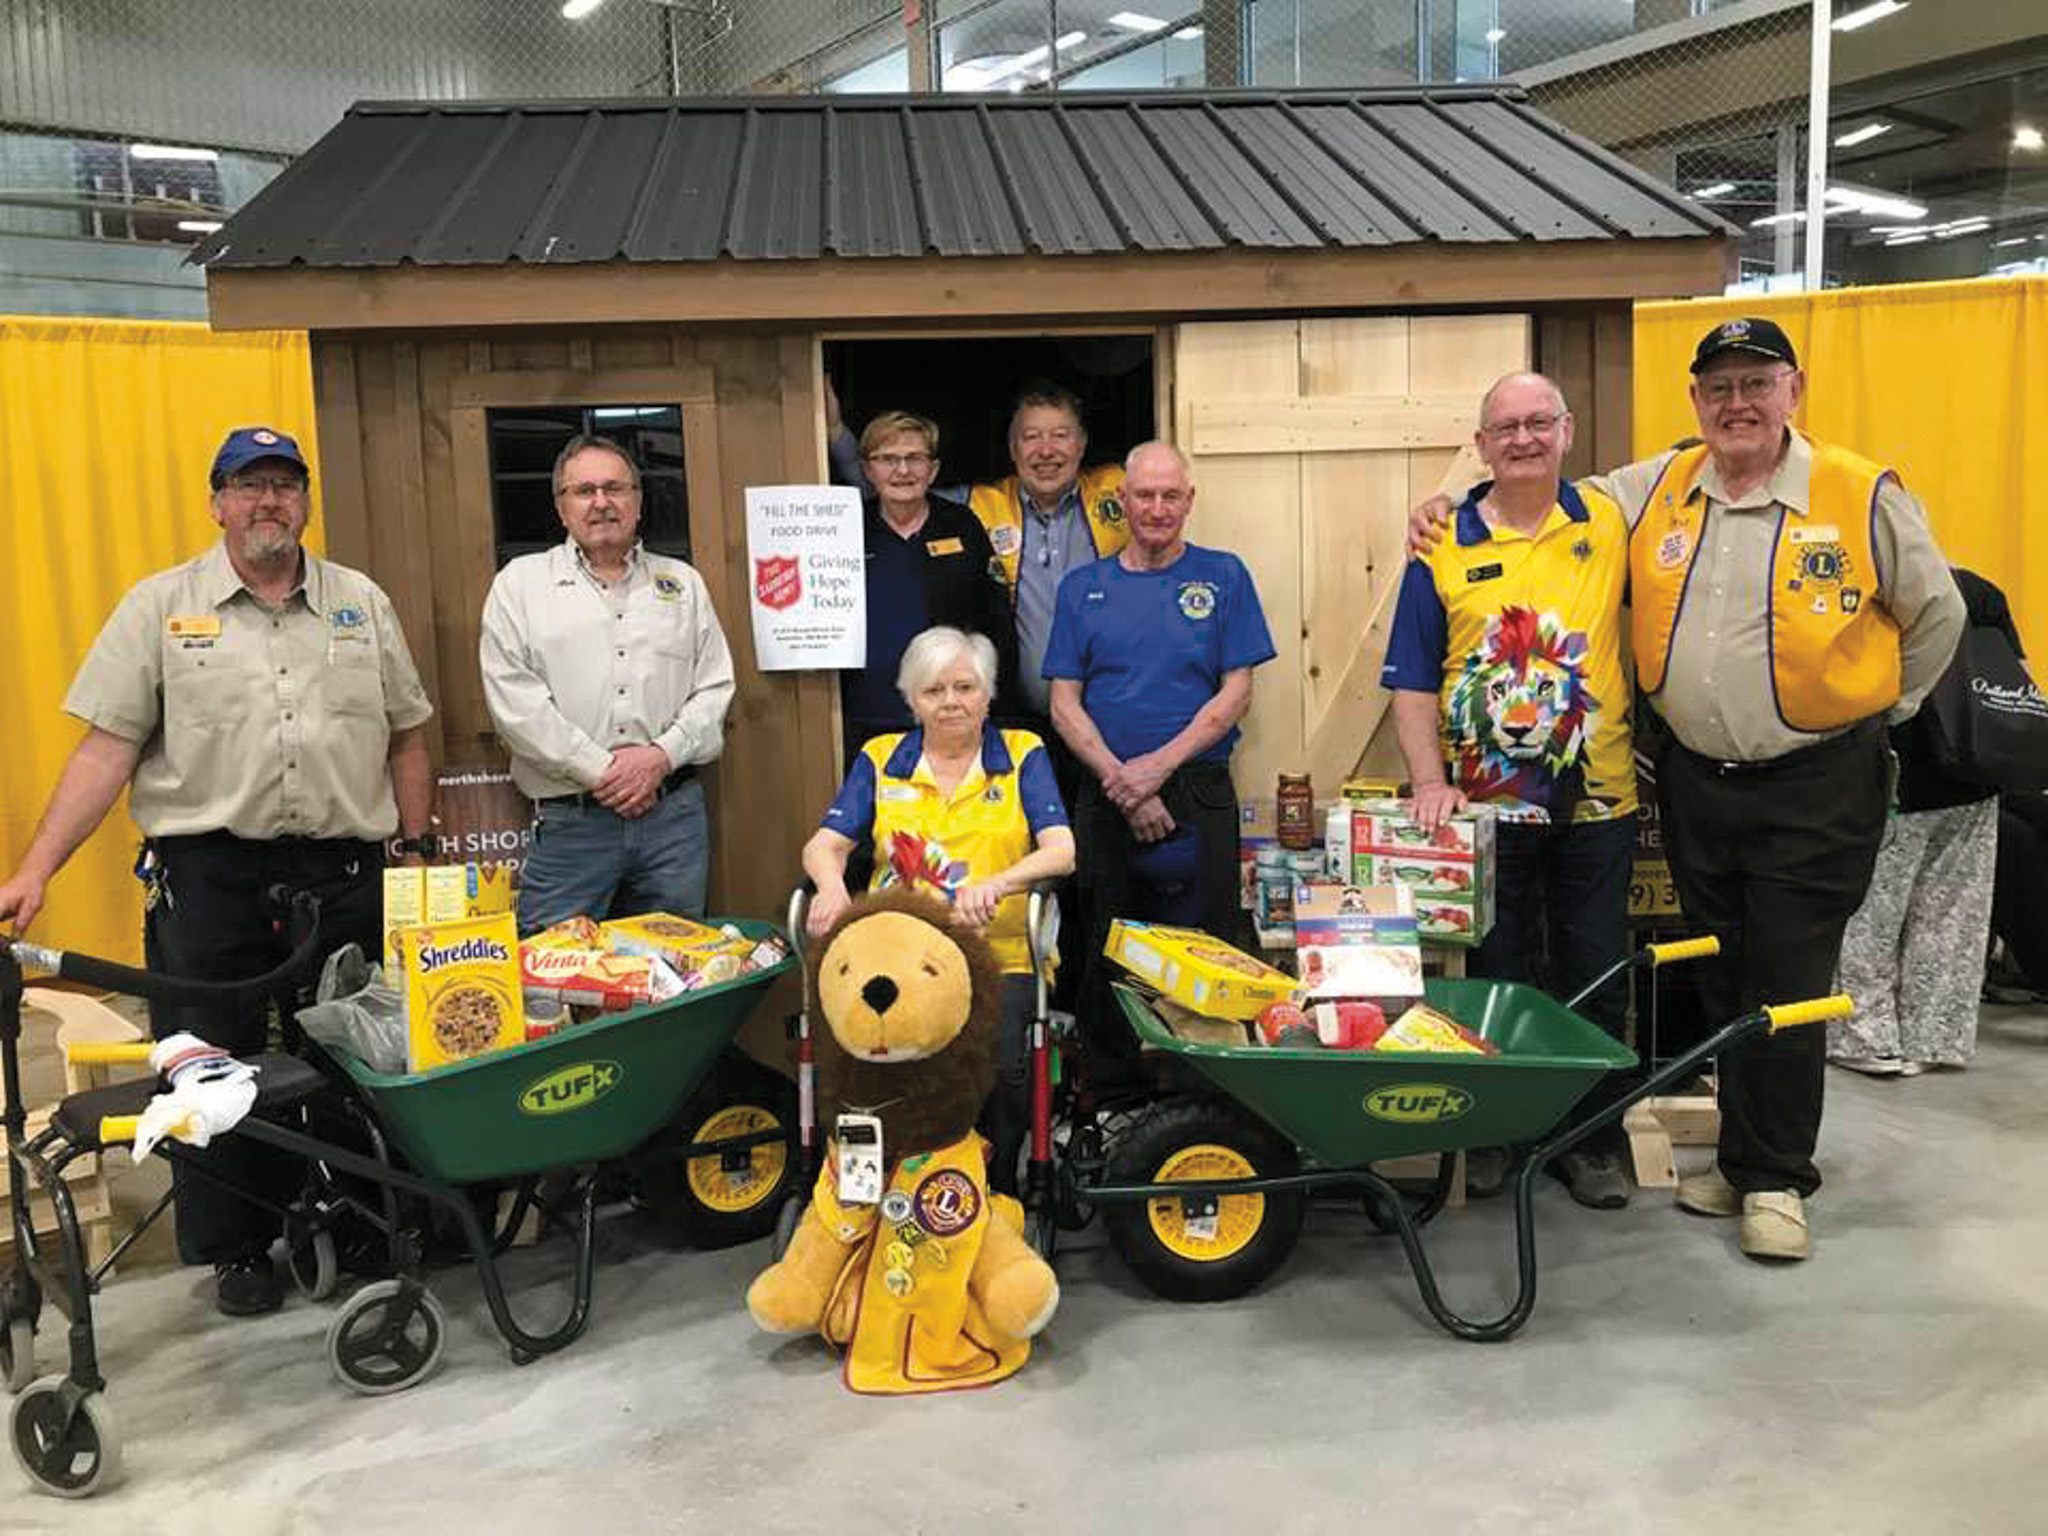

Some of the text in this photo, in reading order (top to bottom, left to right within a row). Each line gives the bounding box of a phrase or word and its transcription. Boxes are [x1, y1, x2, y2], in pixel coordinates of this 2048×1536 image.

[788, 503, 809, 517] THE
[770, 525, 838, 537] FOOD DRIVE
[808, 553, 860, 573] Giving
[809, 574, 851, 592] Hope
[811, 594, 857, 613] Today
[419, 938, 508, 973] Shreddies
[531, 950, 587, 971] Vinta
